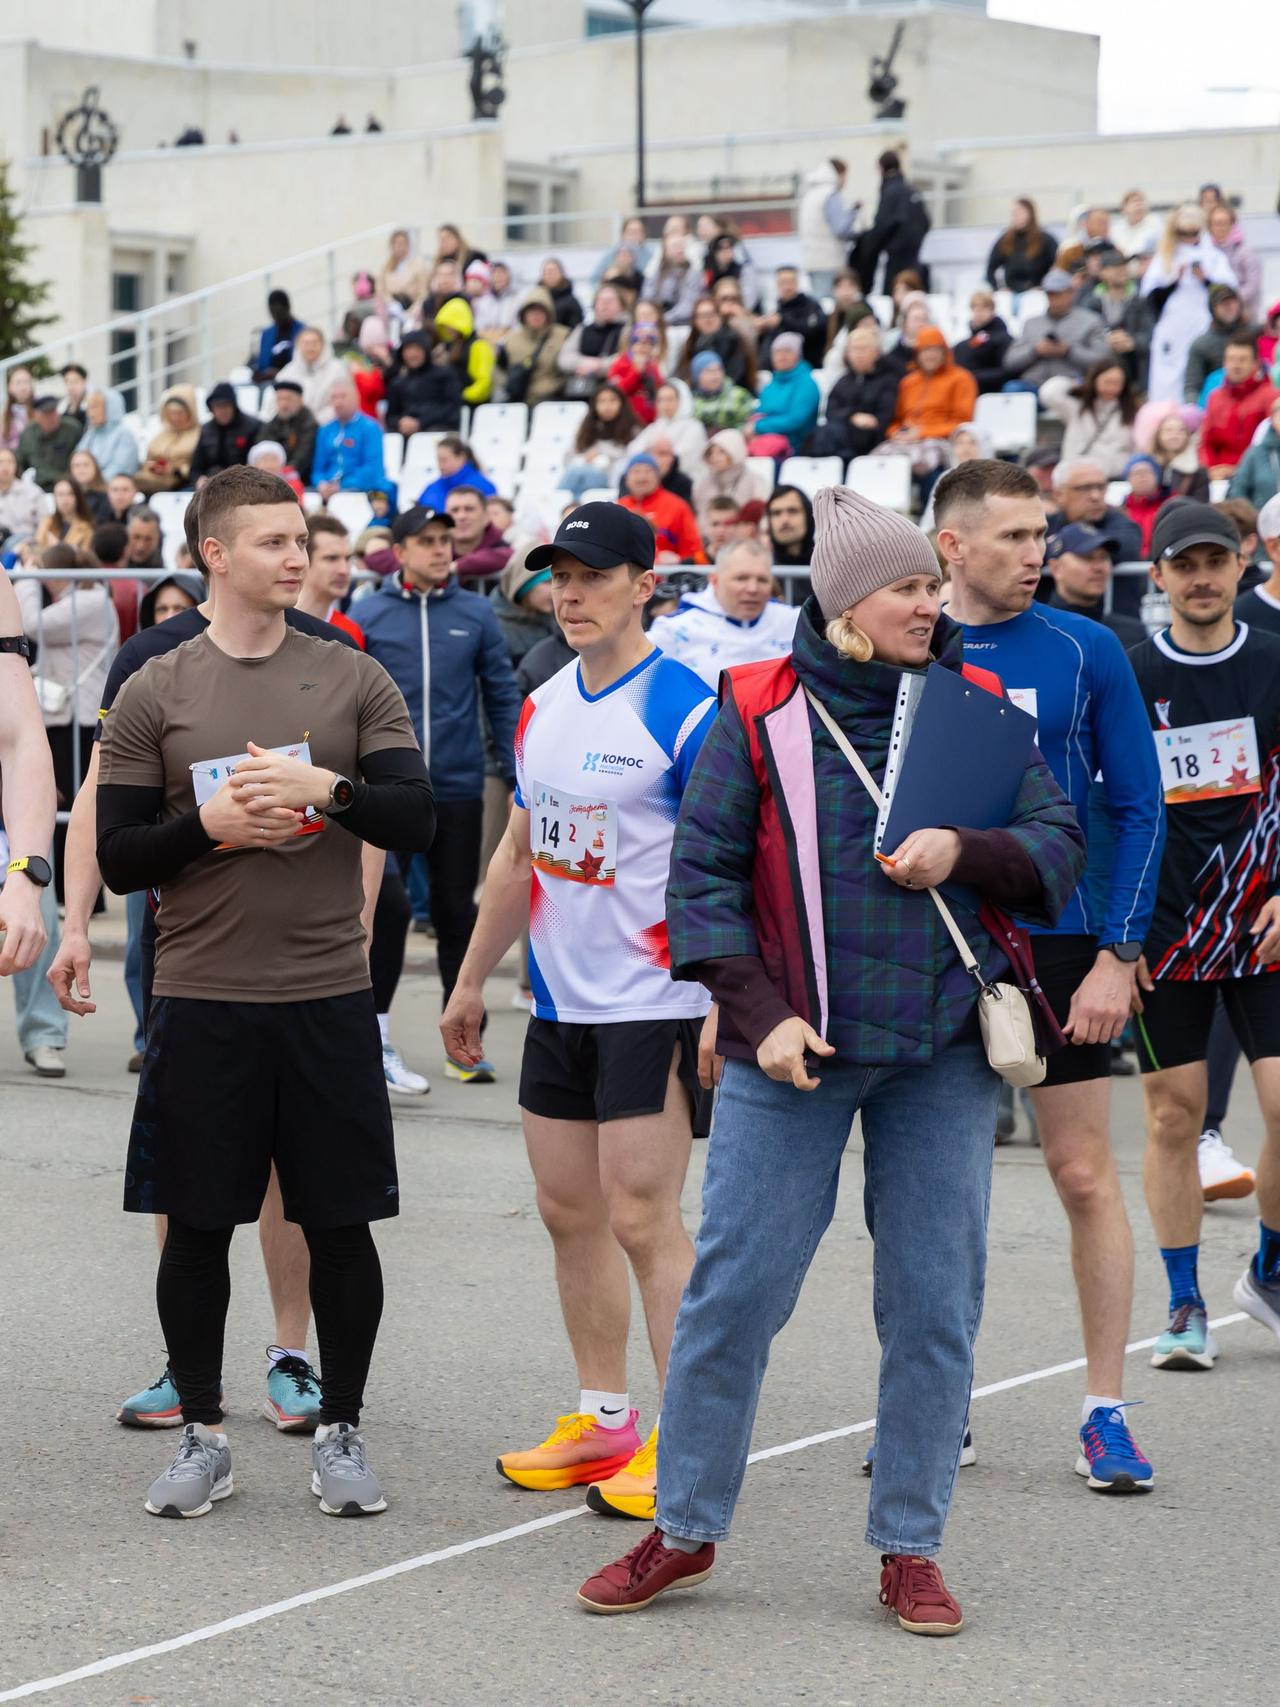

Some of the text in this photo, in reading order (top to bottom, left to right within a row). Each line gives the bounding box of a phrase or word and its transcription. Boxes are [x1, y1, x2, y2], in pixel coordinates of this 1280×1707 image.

[601, 753, 644, 769] КОМОС
[1170, 748, 1221, 779] 18 2
[540, 816, 577, 849] 14 2
